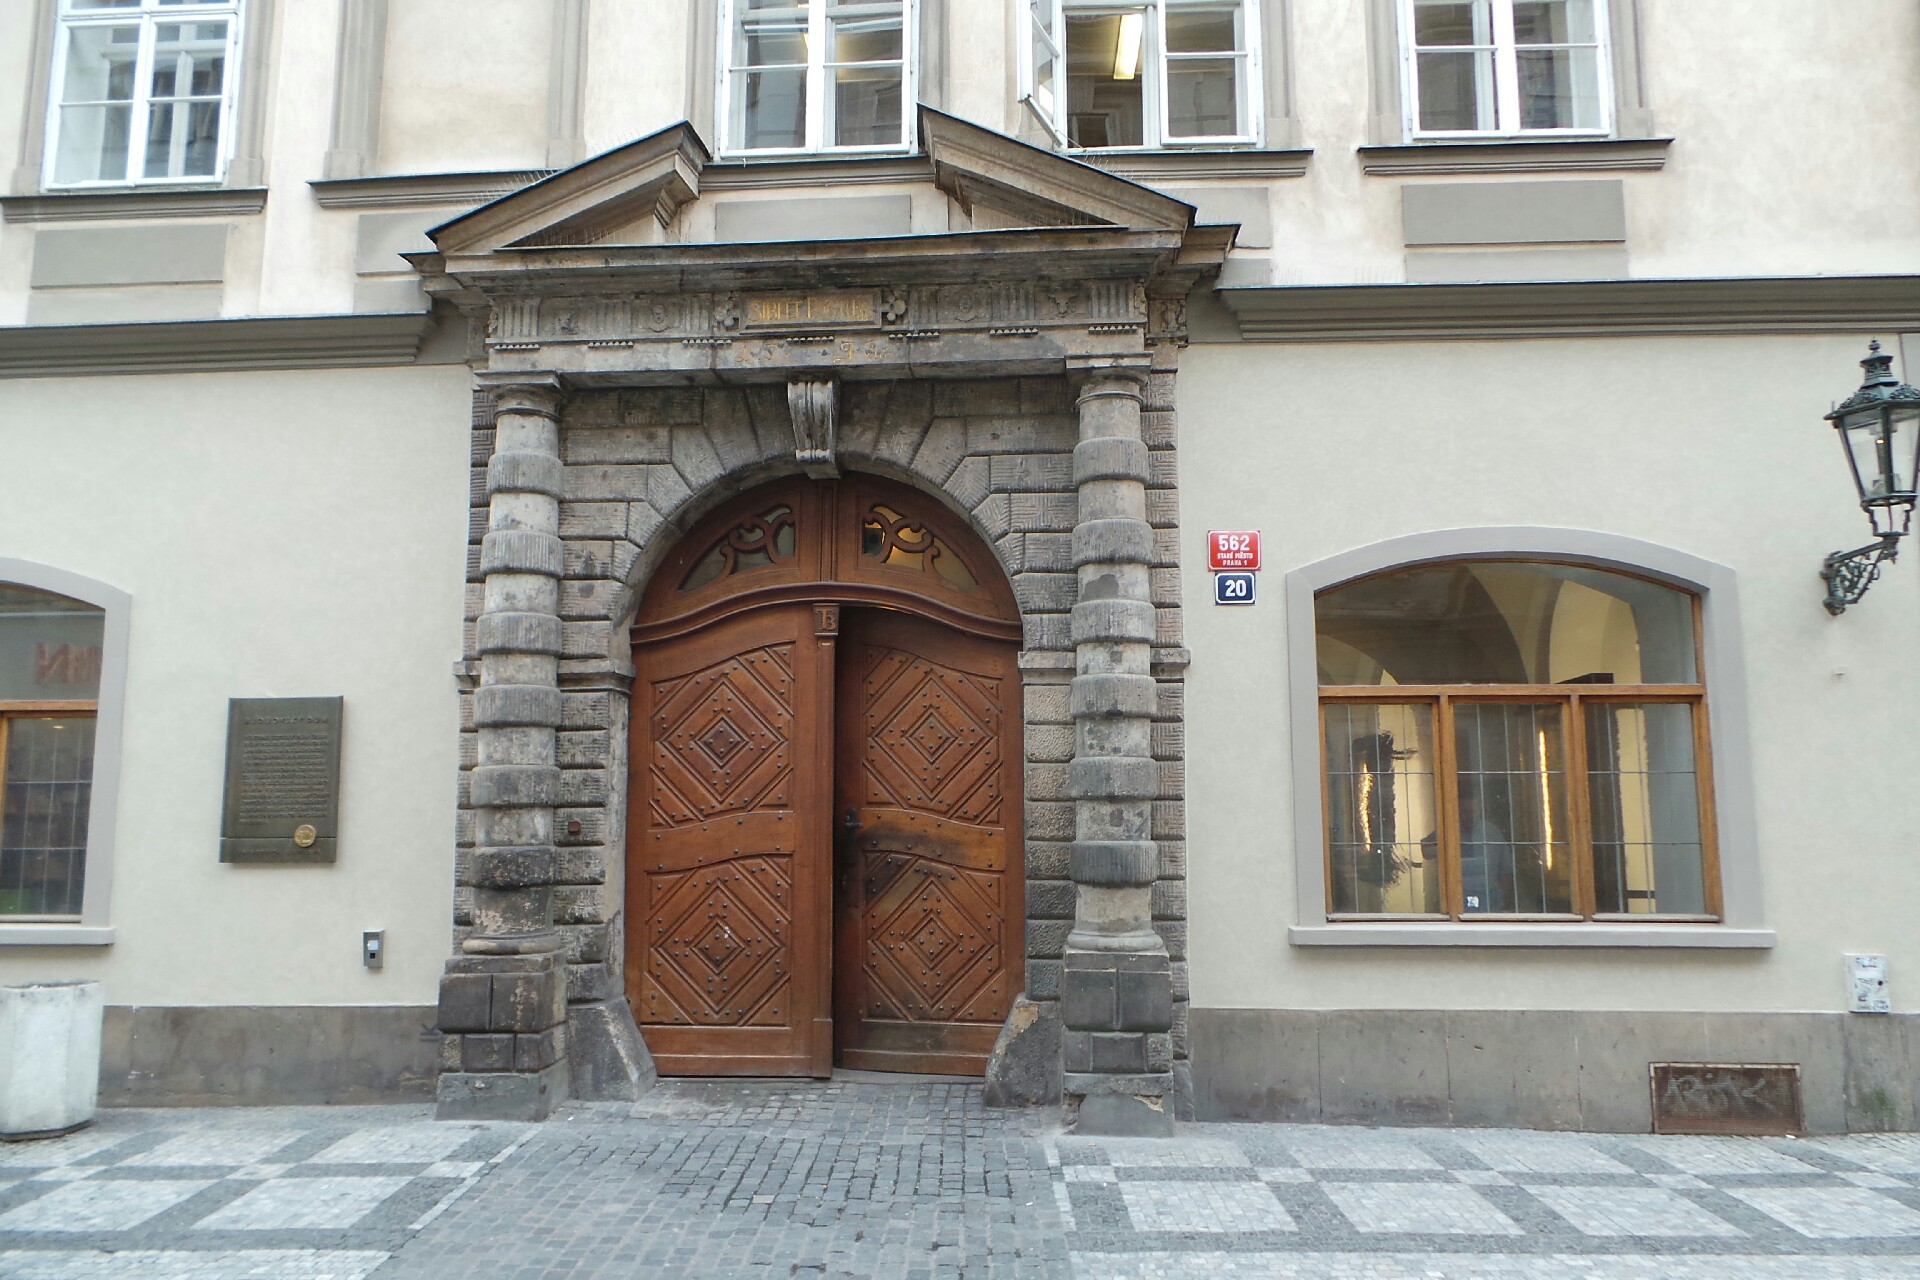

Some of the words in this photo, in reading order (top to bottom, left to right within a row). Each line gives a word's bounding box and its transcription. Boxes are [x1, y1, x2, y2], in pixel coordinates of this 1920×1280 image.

[1218, 535, 1250, 551] 562
[1235, 551, 1253, 559] MĚSTO
[1225, 579, 1246, 597] 20
